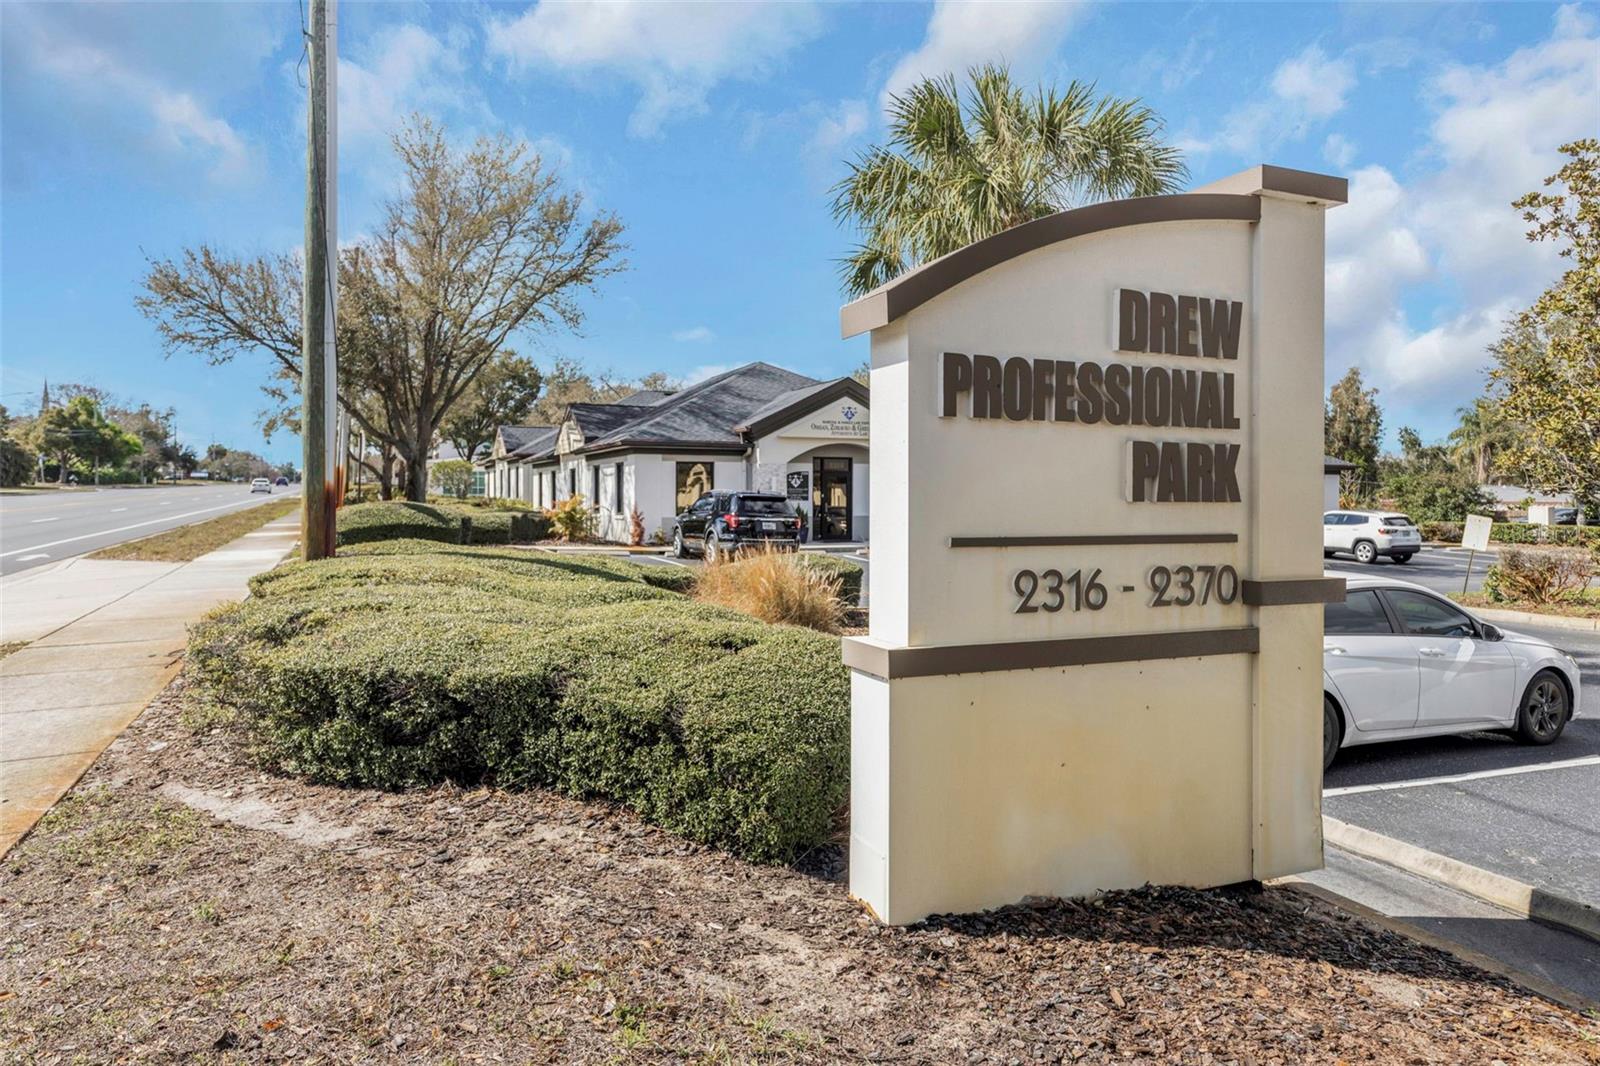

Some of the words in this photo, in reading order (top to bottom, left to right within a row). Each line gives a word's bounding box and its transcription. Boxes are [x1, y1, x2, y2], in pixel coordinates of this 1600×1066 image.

[1117, 288, 1243, 360] DREW
[942, 352, 1241, 430] PROFESSIONAL
[1131, 440, 1242, 503] PARK
[1013, 568, 1108, 614] 2316
[1149, 564, 1239, 608] 2370
